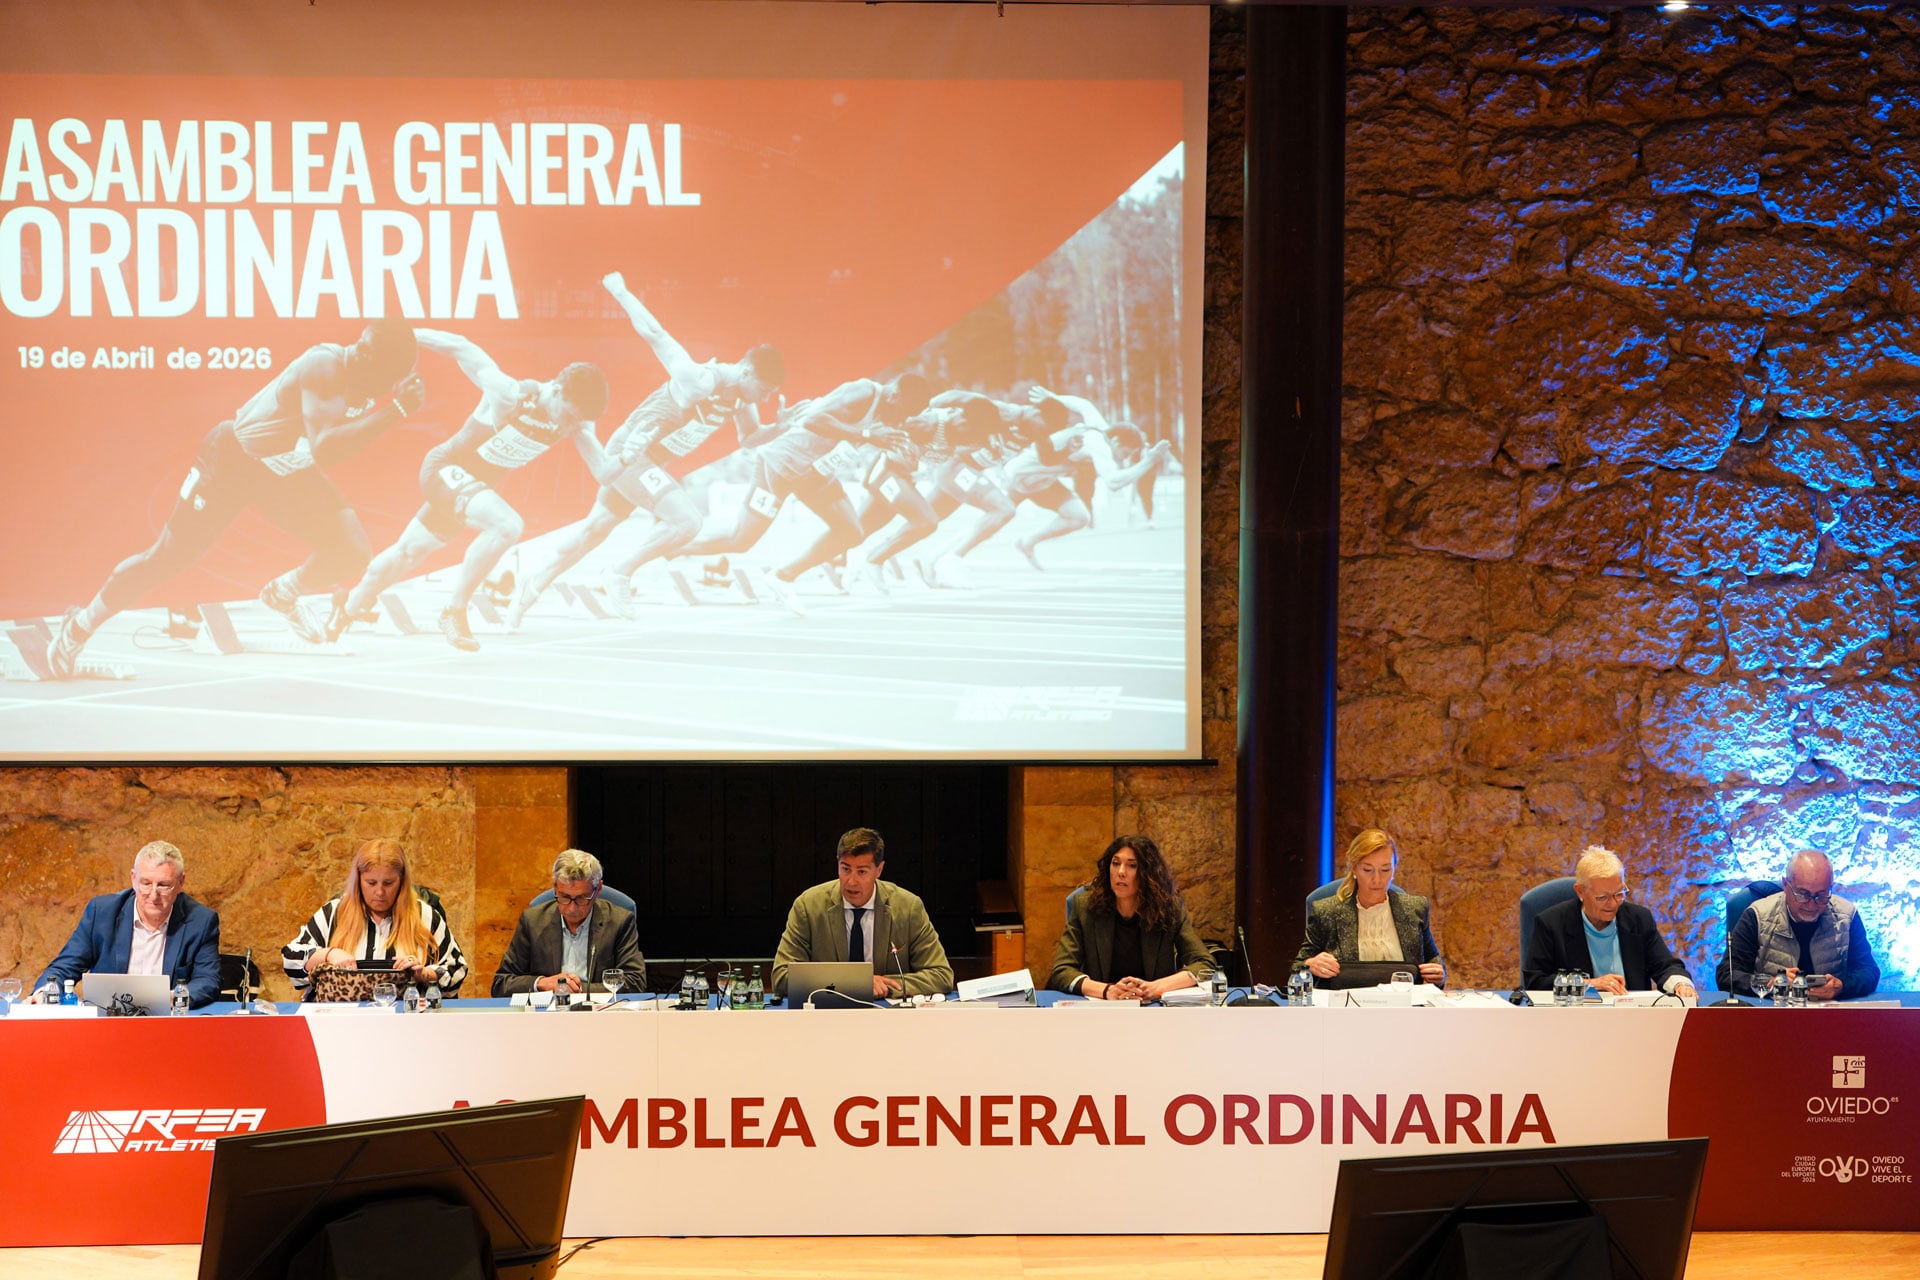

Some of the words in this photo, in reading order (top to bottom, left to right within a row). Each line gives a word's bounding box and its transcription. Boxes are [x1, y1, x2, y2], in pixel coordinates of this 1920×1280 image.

[0, 117, 376, 203] ASAMBLEA
[393, 121, 702, 206] GENERAL
[0, 206, 520, 320] ORDINARIA
[17, 346, 44, 369] 19
[51, 346, 86, 369] de
[91, 345, 154, 370] Abril
[166, 346, 202, 370] de
[207, 347, 272, 370] 2026
[130, 1107, 267, 1140] RFEA
[452, 1097, 816, 1149] MBLEA
[833, 1095, 1146, 1147] GENERAL
[1164, 1094, 1556, 1145] ORDINARIA
[123, 1139, 216, 1152] ATLETIS
[1872, 1155, 1905, 1164] OVIEDO
[1872, 1165, 1892, 1174] VIVE
[1893, 1165, 1902, 1174] EL
[1872, 1175, 1912, 1183] DEPORTE
